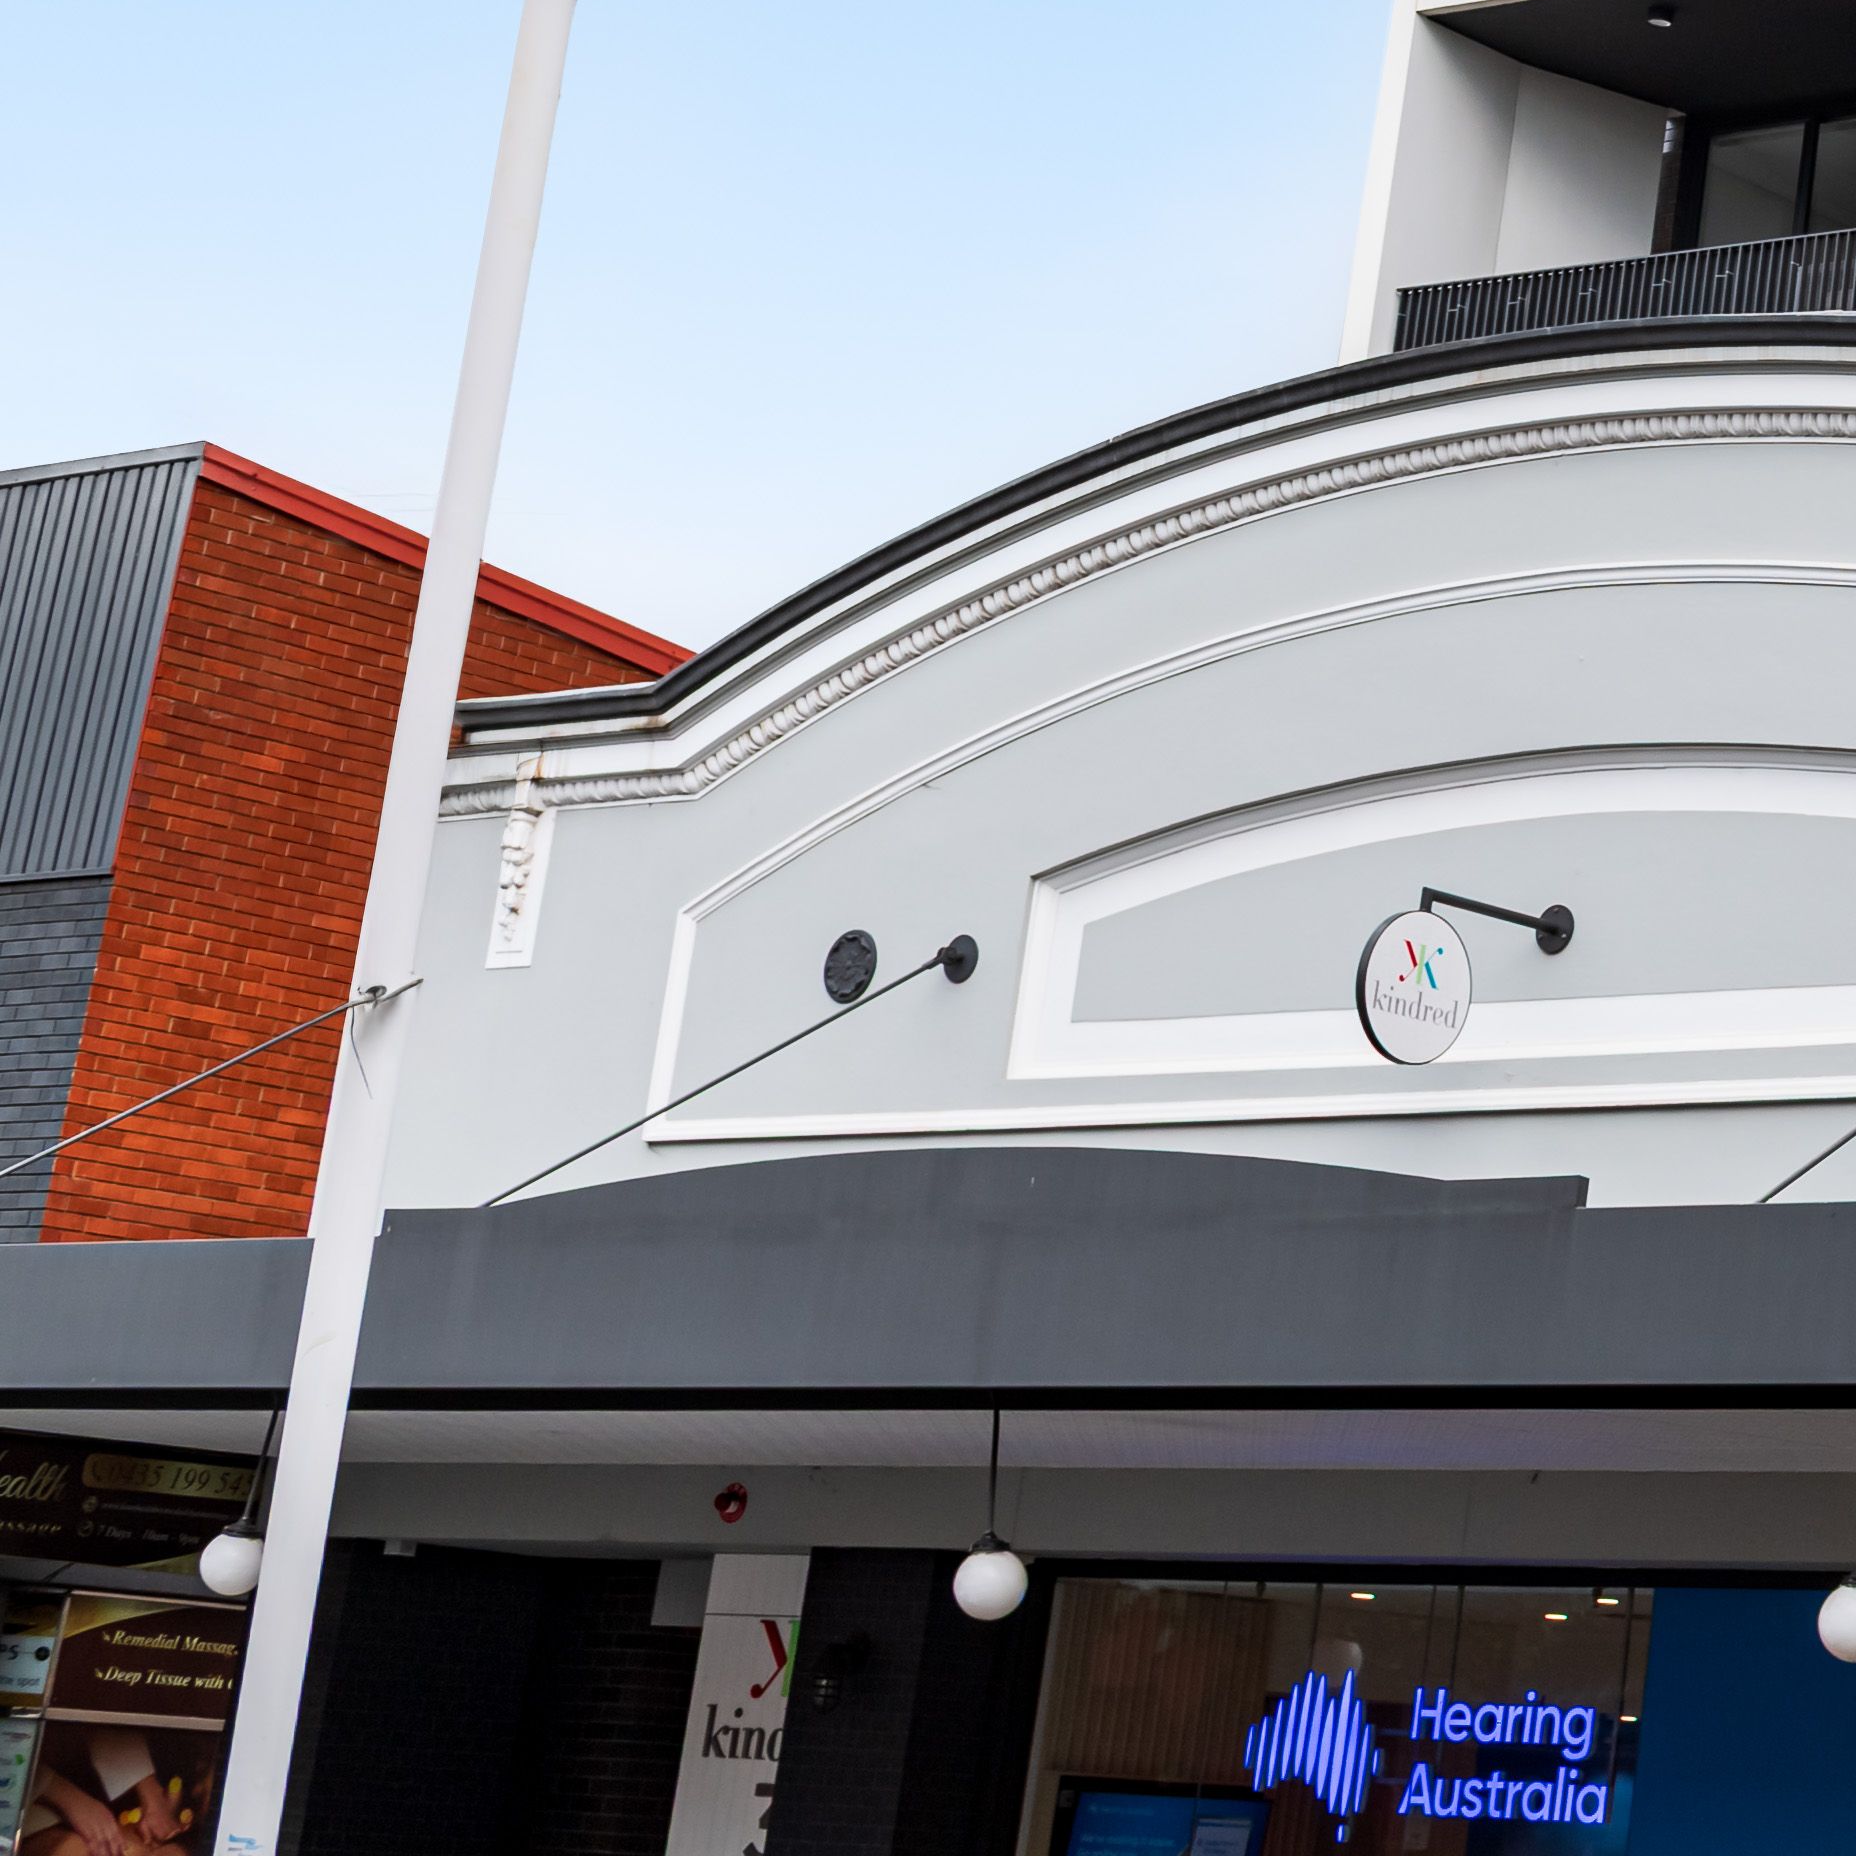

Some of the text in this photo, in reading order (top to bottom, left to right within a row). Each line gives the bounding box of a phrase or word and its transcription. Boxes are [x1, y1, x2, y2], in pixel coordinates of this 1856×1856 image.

[1371, 980, 1459, 1030] kindred
[0, 1458, 70, 1502] ealth
[170, 1466, 211, 1491] 199
[111, 1630, 239, 1656] Remedial Massag
[104, 1666, 223, 1690] Deep Tissue with
[1409, 1686, 1597, 1761] Hearing
[1398, 1763, 1609, 1826] Australia
